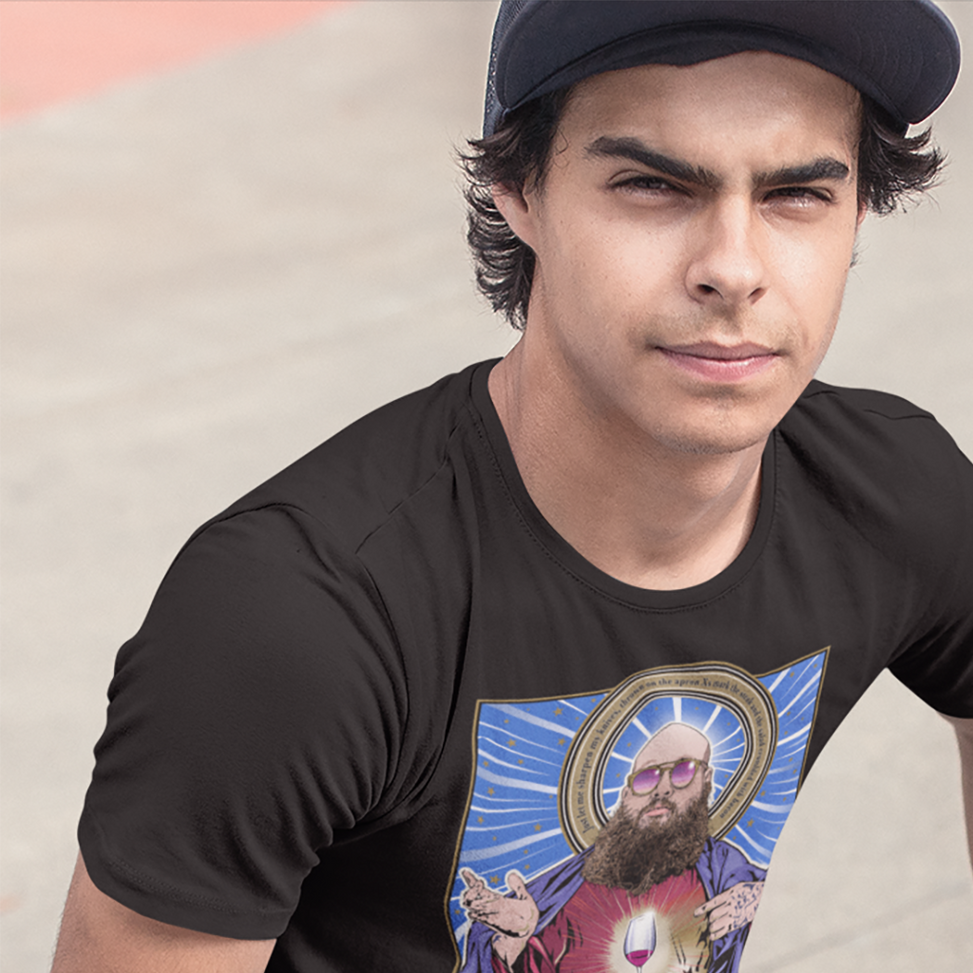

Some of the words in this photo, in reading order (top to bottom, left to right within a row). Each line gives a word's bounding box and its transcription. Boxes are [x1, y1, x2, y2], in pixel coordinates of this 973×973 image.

[658, 678, 672, 686] the
[675, 679, 699, 687] apron
[596, 709, 621, 735] knives,
[590, 735, 603, 749] my
[576, 751, 593, 788] sharpen
